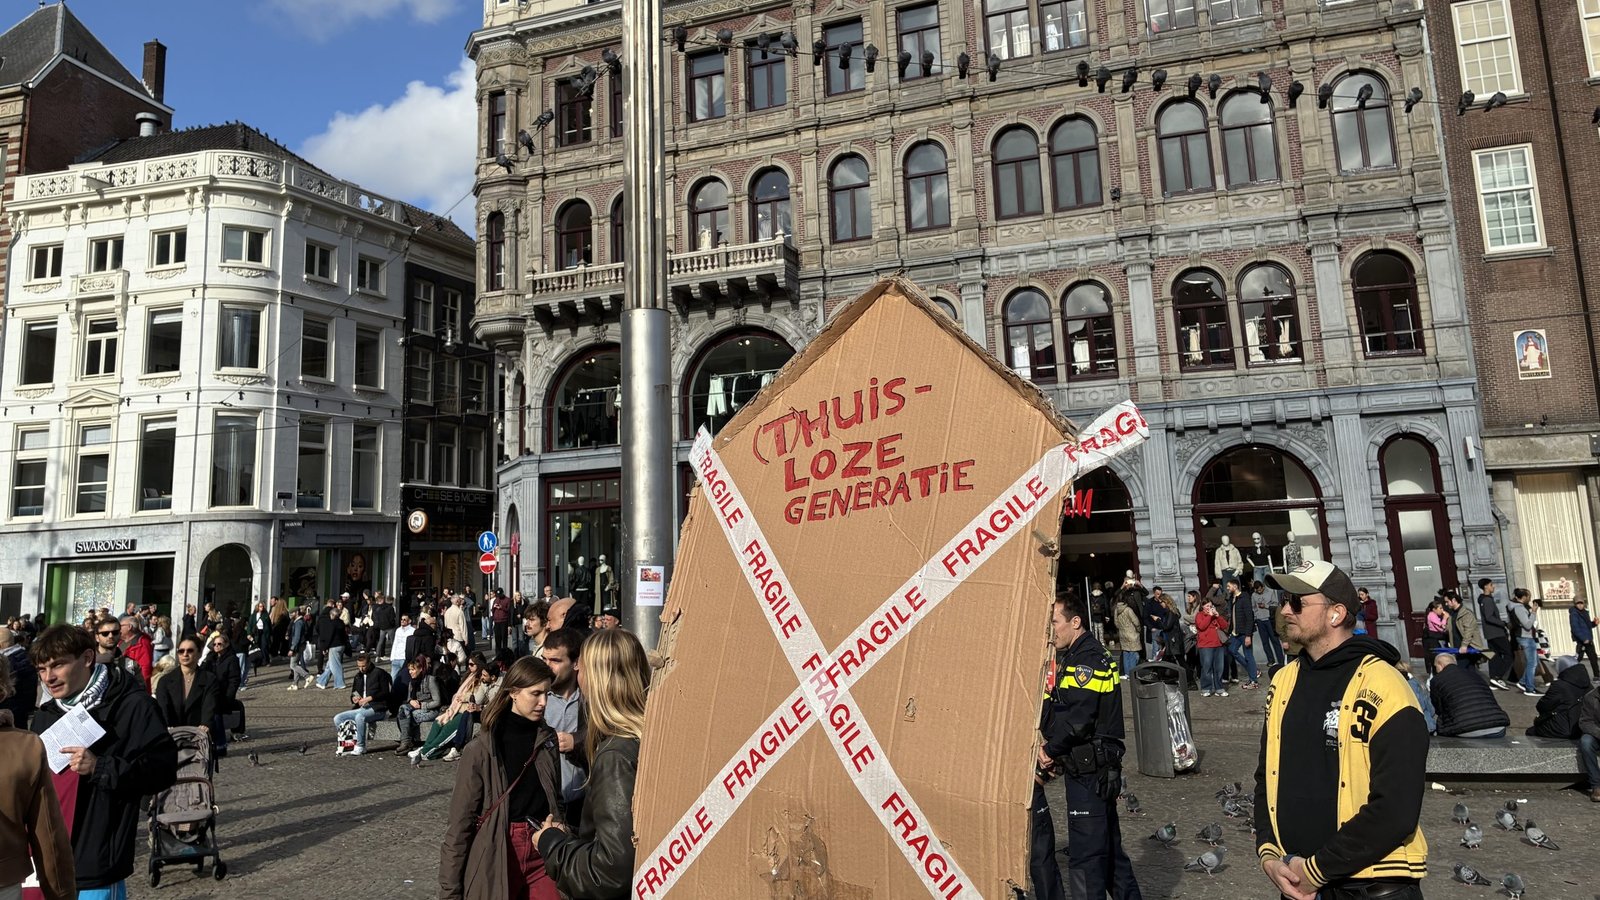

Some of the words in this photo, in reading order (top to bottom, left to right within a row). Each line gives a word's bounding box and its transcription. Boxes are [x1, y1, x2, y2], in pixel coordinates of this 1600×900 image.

[76, 539, 132, 553] SWAROVSKI
[784, 433, 905, 493] LOZE
[635, 805, 714, 900] FRAGILE
[722, 696, 812, 800] FRAGILE
[825, 585, 927, 690] FRAGILE
[941, 474, 1050, 578] FRAGILE
[742, 539, 803, 640] FRAGILE
[801, 652, 876, 774] FRAGILE
[881, 791, 964, 900] FRAGIL
